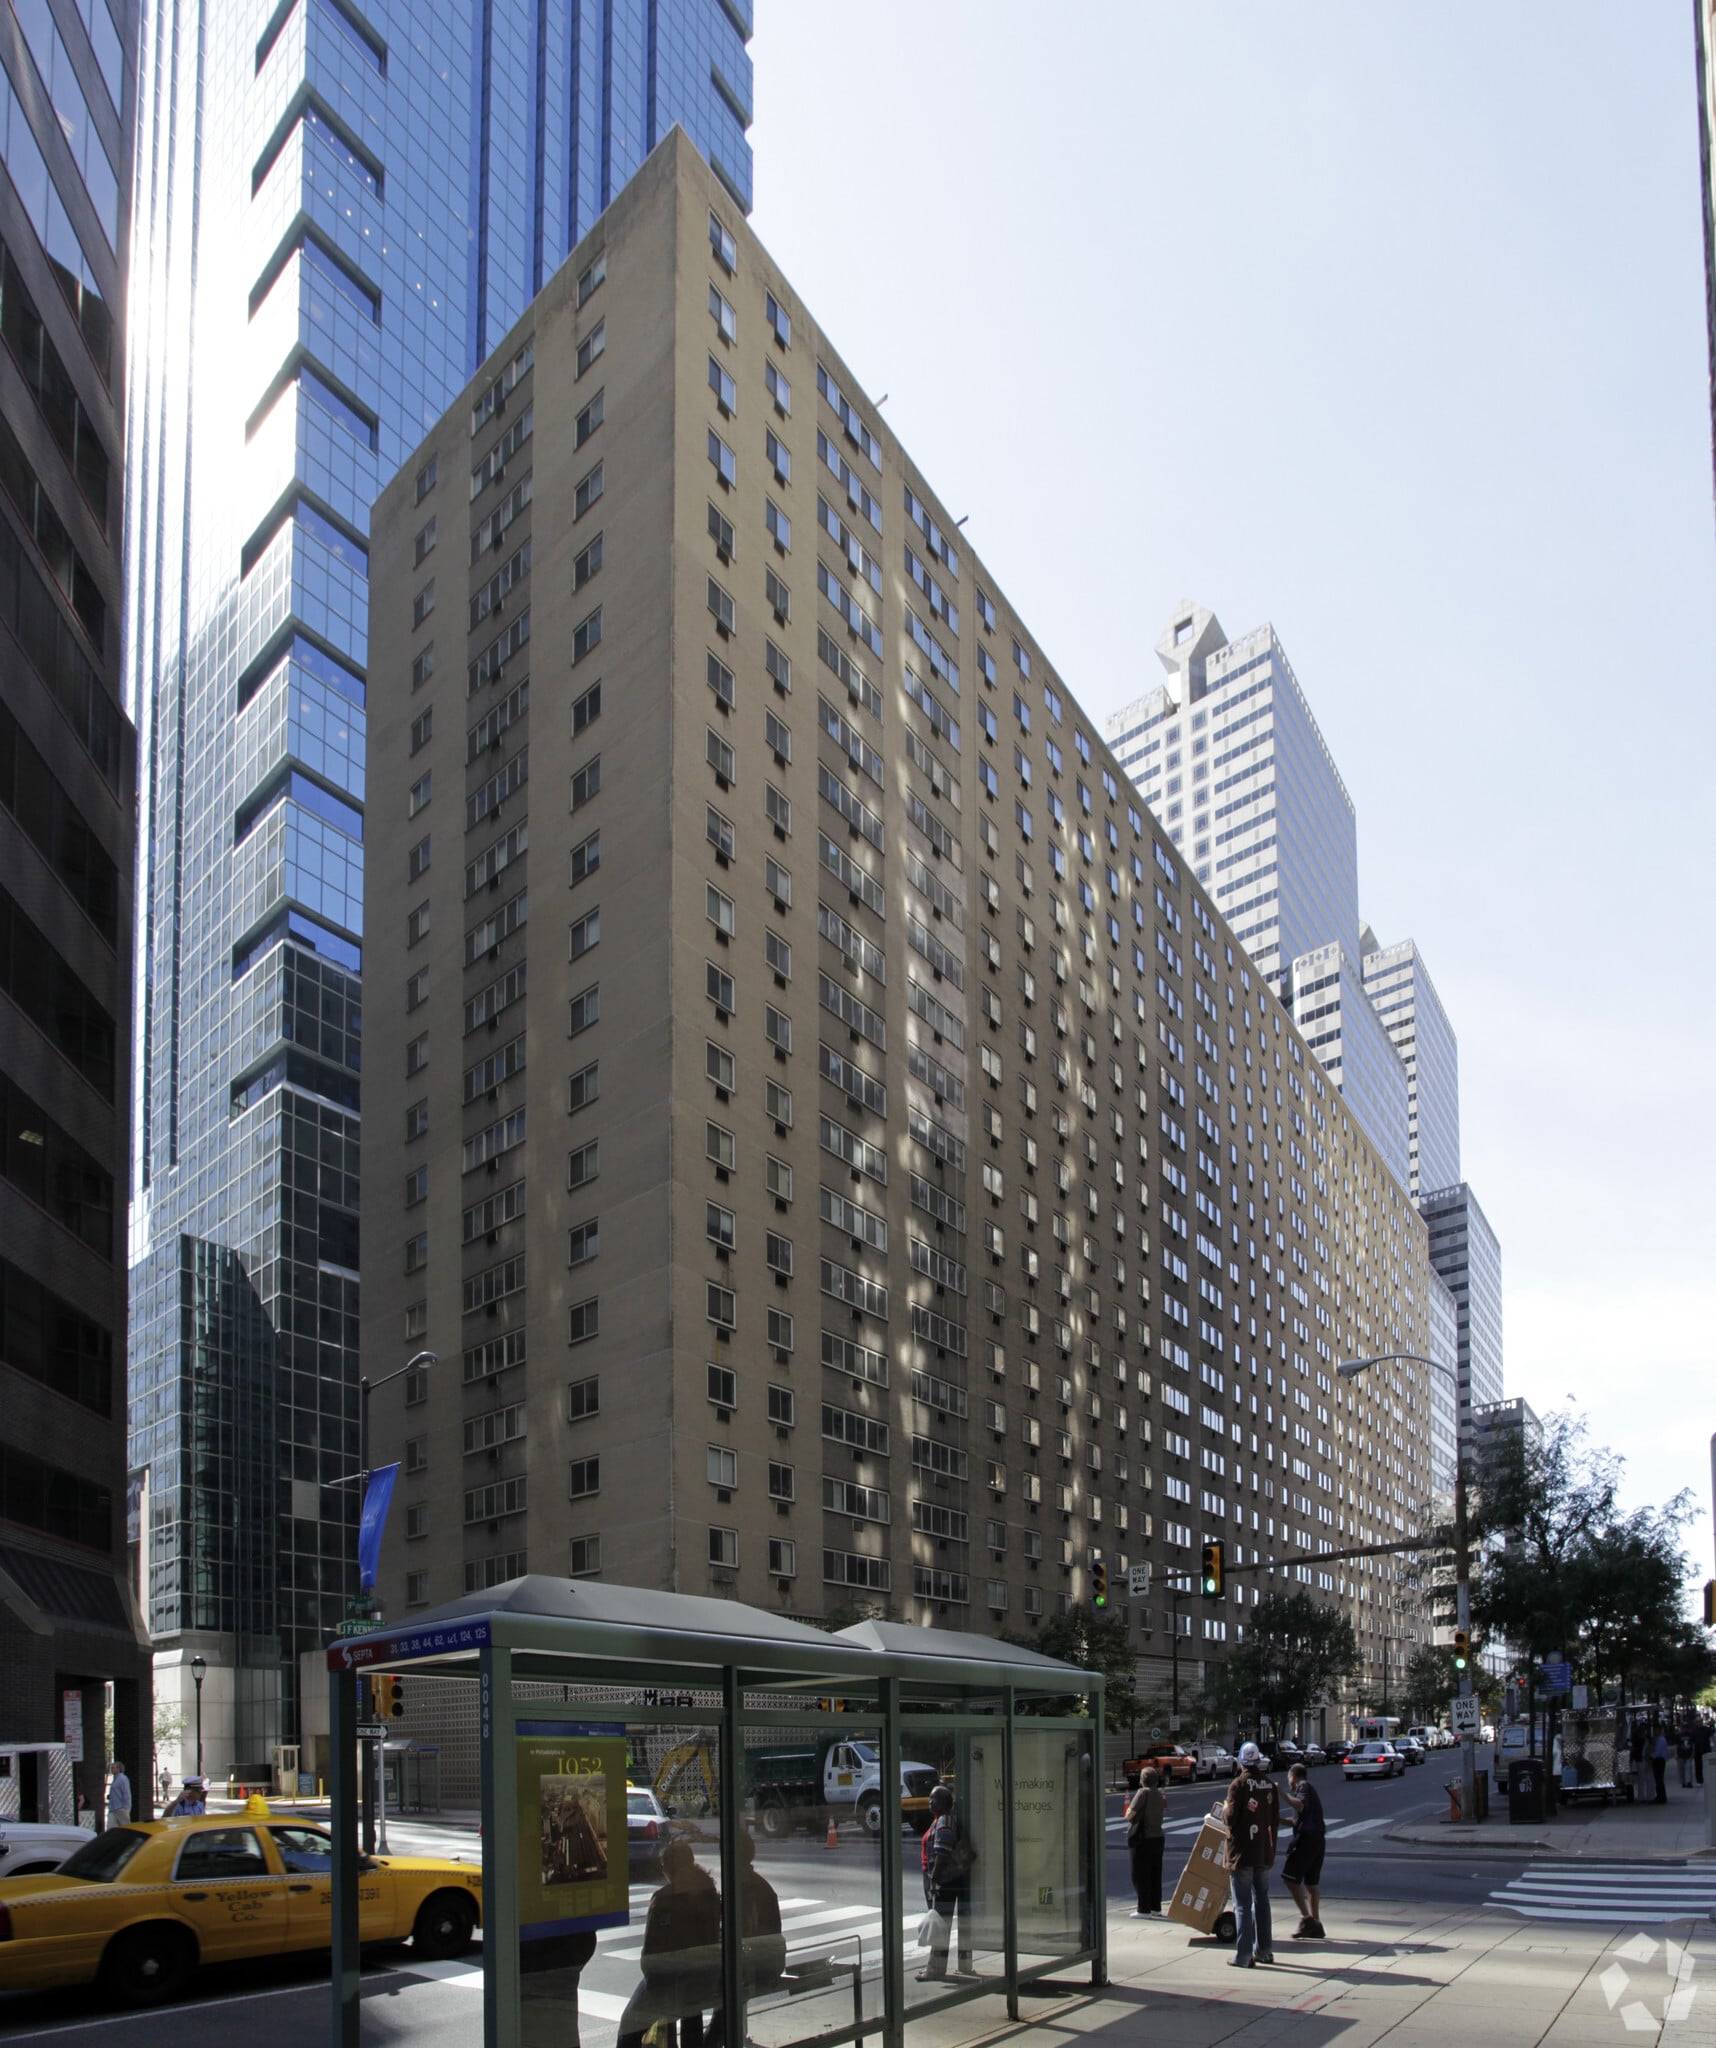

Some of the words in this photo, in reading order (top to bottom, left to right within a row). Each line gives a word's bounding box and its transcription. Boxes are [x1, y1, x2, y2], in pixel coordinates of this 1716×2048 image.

[1132, 1567, 1146, 1576] ONE
[1132, 1576, 1146, 1584] WAY
[475, 1627, 487, 1639] 125
[353, 1648, 374, 1662] SEPTA
[1456, 1700, 1475, 1710] ONE
[1456, 1710, 1475, 1720] WAY
[557, 1757, 603, 1784] 1952
[1019, 1778, 1055, 1793] making
[215, 1890, 273, 1902] Yellow
[228, 1900, 263, 1912] Cab
